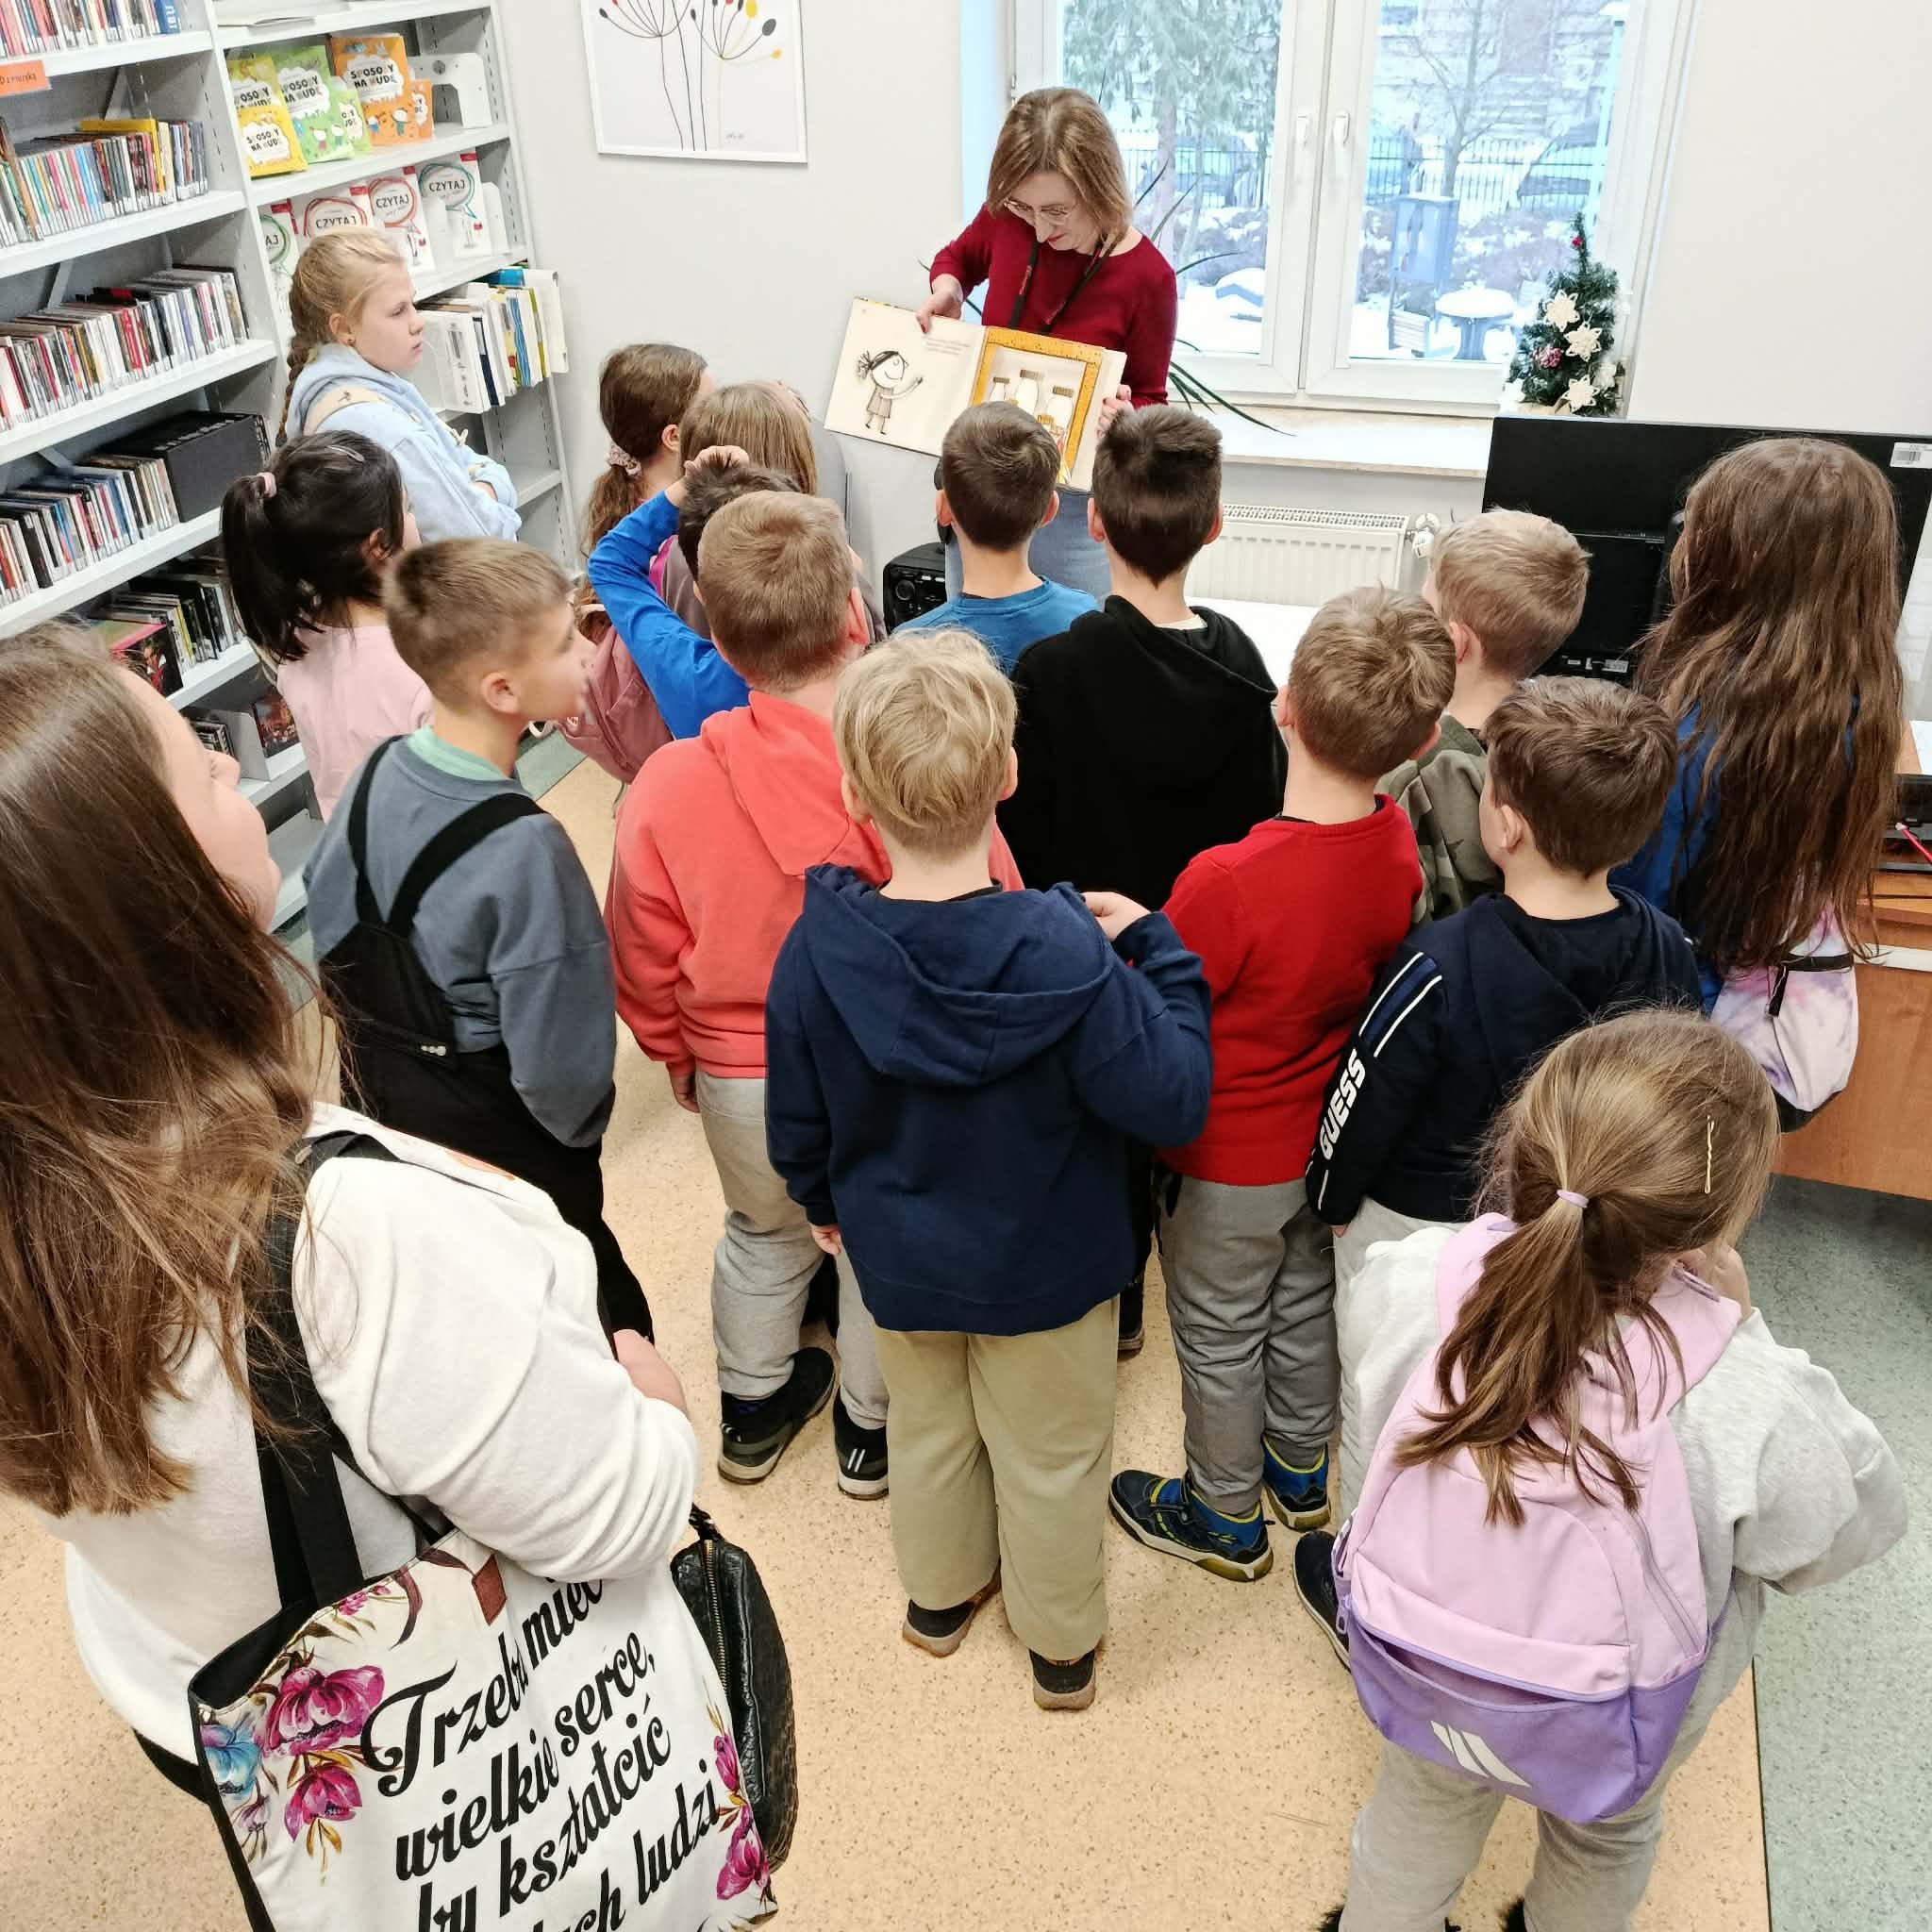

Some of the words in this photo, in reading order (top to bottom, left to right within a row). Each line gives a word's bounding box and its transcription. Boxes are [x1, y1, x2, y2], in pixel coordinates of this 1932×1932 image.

[281, 75, 318, 93] OSOY
[234, 86, 270, 106] OSOY
[246, 128, 279, 143] SOSOY
[263, 138, 282, 149] UD
[429, 179, 465, 192] CZYTAJ
[375, 193, 409, 208] CZYTAJ
[1320, 1048, 1366, 1160] GUESS
[396, 1728, 559, 1880] wielkie
[555, 1632, 656, 1757] serce,
[499, 1692, 671, 1918] kształcić
[633, 1758, 720, 1906] ludzi
